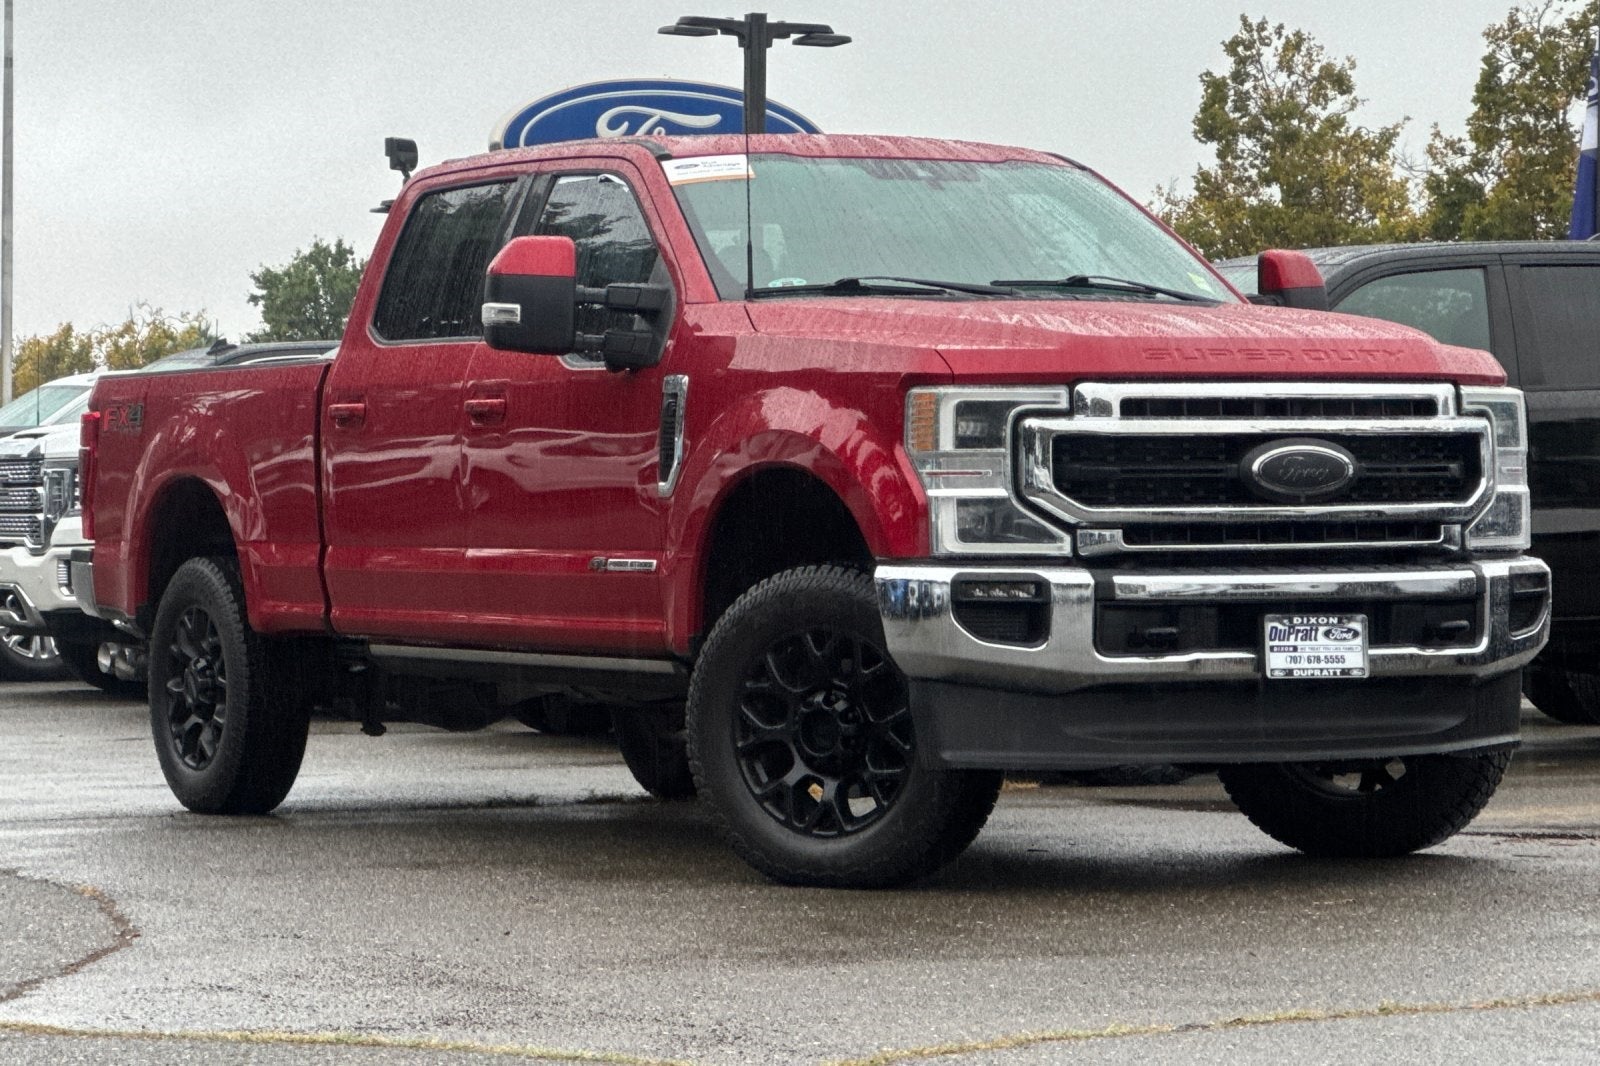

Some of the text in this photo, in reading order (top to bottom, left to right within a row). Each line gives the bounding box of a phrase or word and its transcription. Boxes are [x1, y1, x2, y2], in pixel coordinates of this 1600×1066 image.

[1142, 348, 1404, 361] SUPER DUTY
[103, 403, 144, 431] FX4
[1293, 616, 1338, 624] DIXON
[1269, 625, 1320, 641] DuPratt
[1329, 628, 1353, 640] Ford
[1286, 655, 1346, 665] (707) 678-5555
